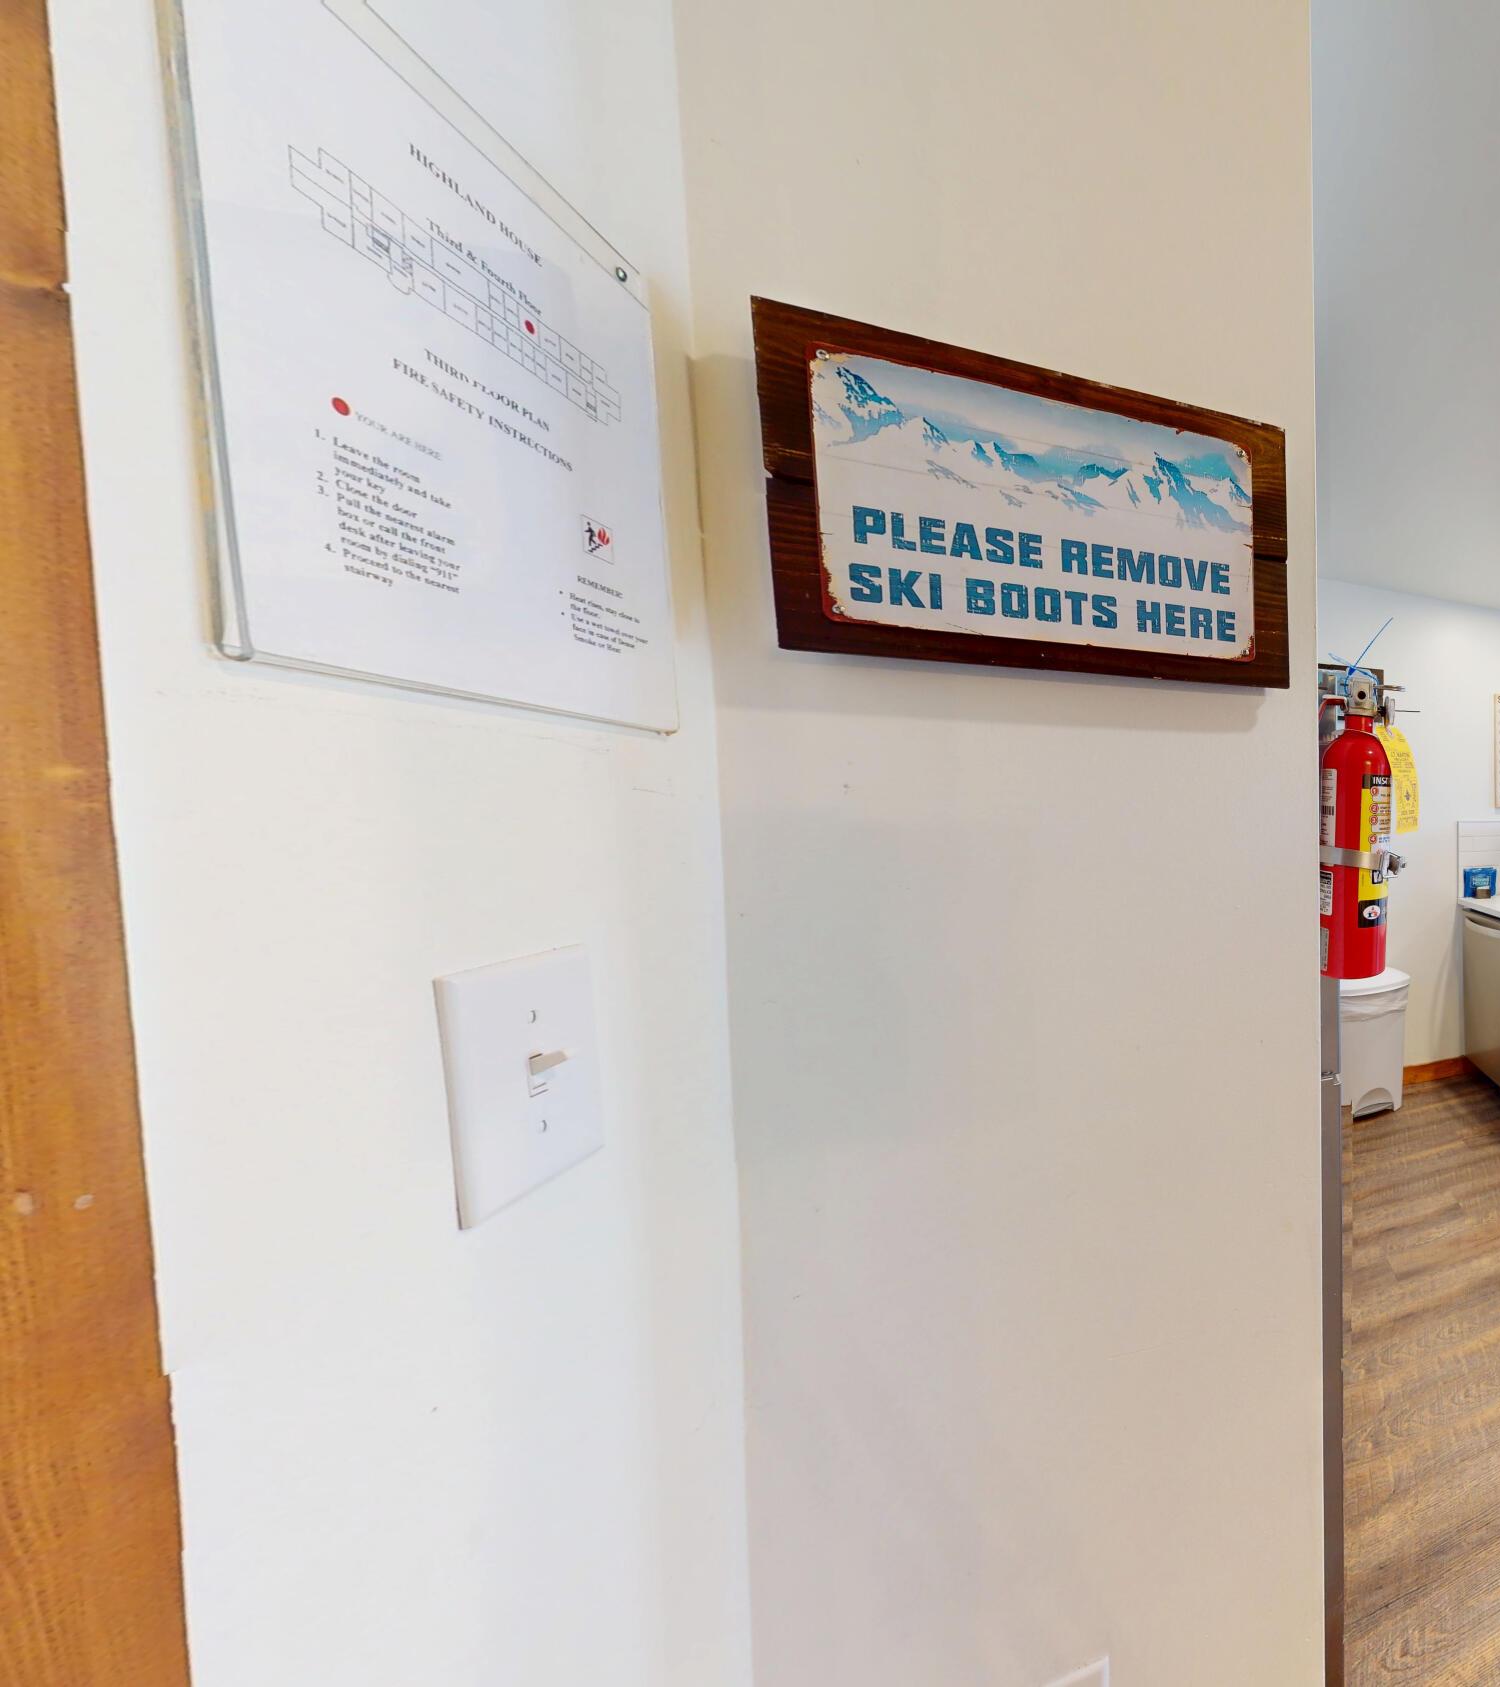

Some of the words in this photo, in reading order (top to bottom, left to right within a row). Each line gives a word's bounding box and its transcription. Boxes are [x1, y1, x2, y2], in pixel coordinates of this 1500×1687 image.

[409, 142, 496, 225] HIGHLAND
[499, 220, 543, 268] HOUSE
[426, 216, 463, 253] Third
[466, 250, 478, 264] &
[480, 260, 516, 294] Fourth
[518, 290, 542, 316] Floor
[393, 357, 429, 388] FIRE
[431, 382, 484, 420] SAFETY
[488, 414, 574, 472] INSTRUCTIONS
[424, 348, 470, 383] THIRD
[472, 380, 520, 414] FLOOR
[522, 407, 550, 432] PLAN
[315, 428, 326, 441] 1.
[333, 436, 369, 460] Leave
[372, 455, 390, 470] the
[393, 466, 421, 484] room
[333, 450, 404, 490] immediately
[407, 485, 427, 499] and
[430, 493, 452, 509] take
[334, 466, 364, 484] your
[366, 478, 386, 495] key
[316, 470, 329, 483] 2.
[335, 479, 368, 500] Close
[371, 493, 389, 508] the
[392, 502, 418, 519] door
[316, 485, 330, 497] 3.
[336, 492, 361, 510] Pull
[364, 504, 382, 518] the
[385, 513, 424, 534] nearest
[426, 530, 456, 546] alarm
[337, 506, 360, 522] box
[362, 517, 376, 528] or
[378, 523, 398, 537] call
[401, 532, 418, 544] the
[420, 538, 446, 554] front
[338, 521, 367, 538] desk
[369, 533, 396, 548] after
[398, 542, 436, 564] leaving
[437, 558, 461, 573] your
[340, 536, 371, 553] room
[374, 546, 388, 560] by
[391, 553, 429, 574] dialing
[852, 505, 1043, 569] PLEASE
[1060, 538, 1230, 596] REMOVE
[342, 548, 389, 571] Proceed
[391, 565, 403, 576] to
[405, 569, 422, 582] the
[424, 577, 460, 594] nearest
[343, 564, 394, 587] stairway
[848, 562, 943, 611] SKI
[965, 577, 1118, 629] BOOTS
[1136, 599, 1236, 643] HERE
